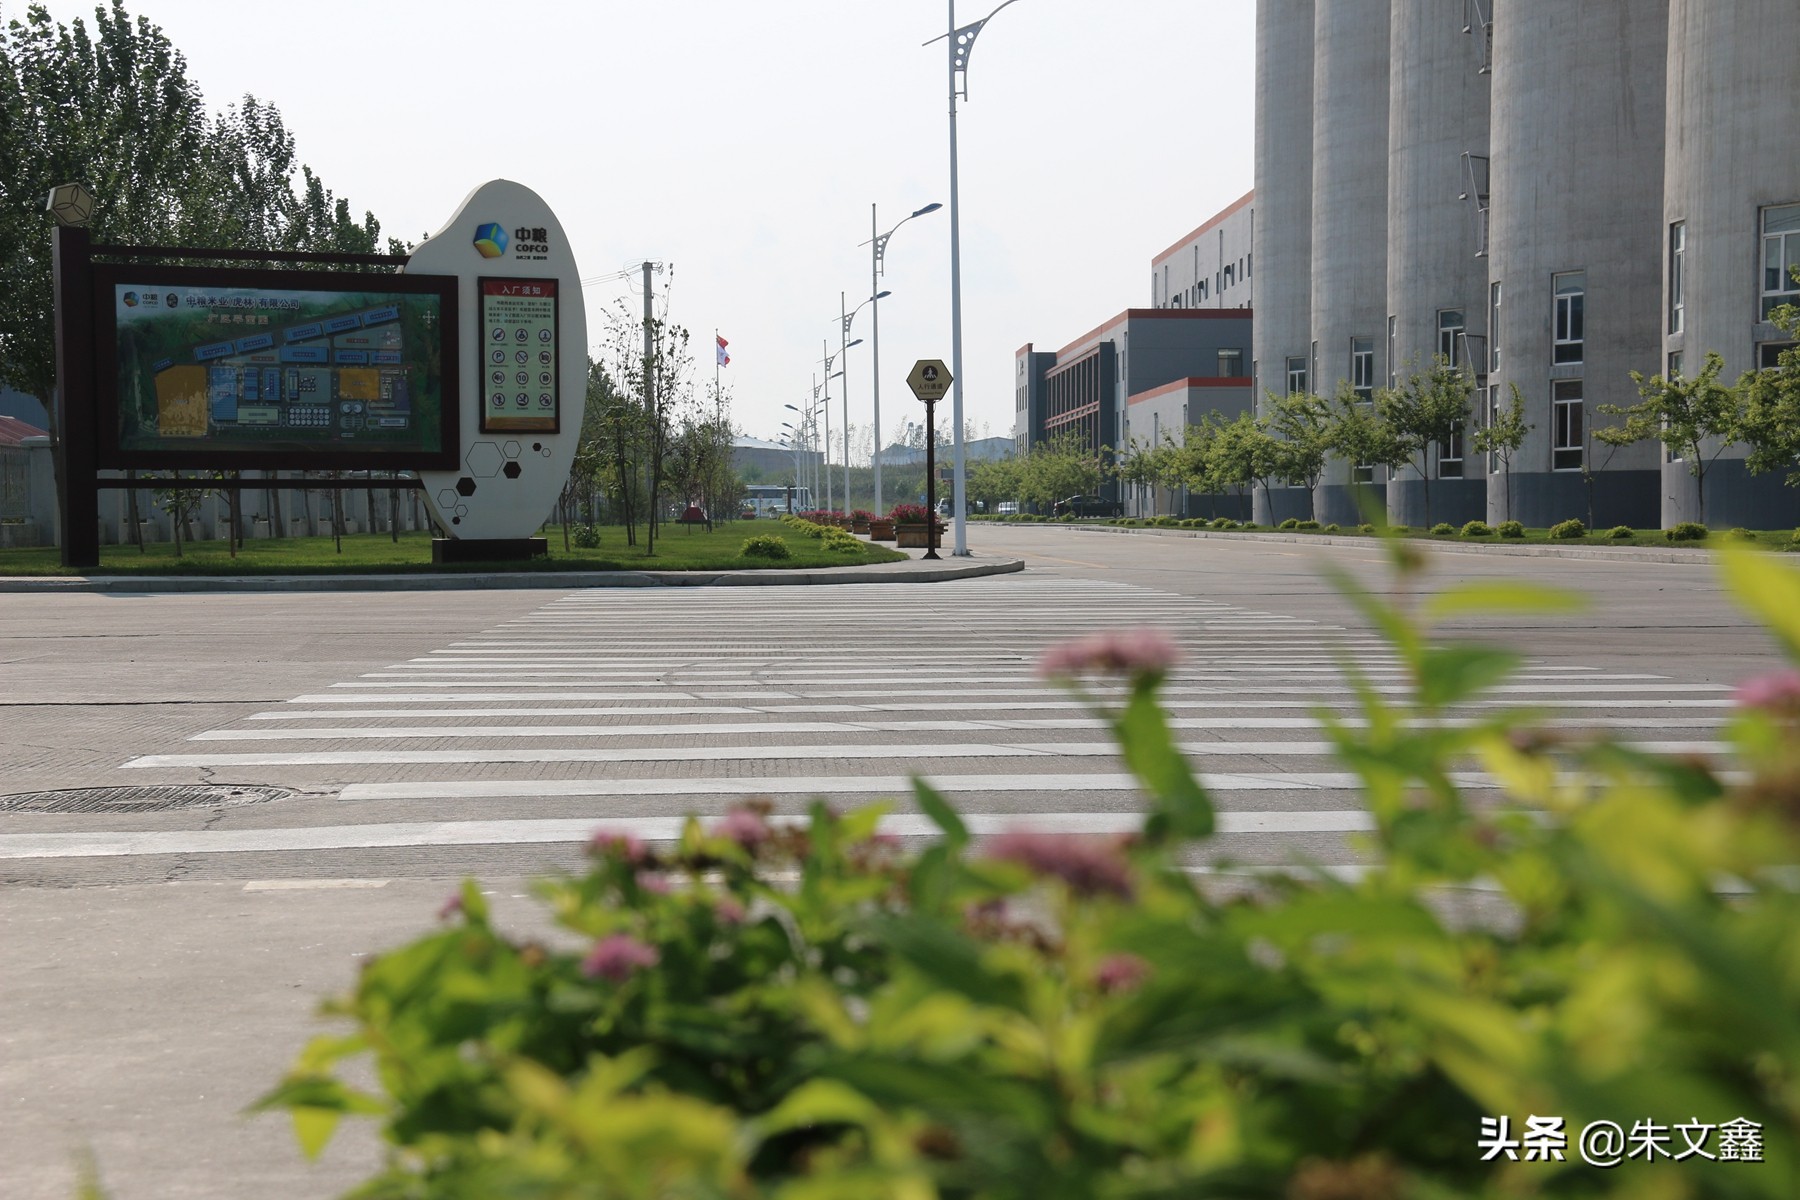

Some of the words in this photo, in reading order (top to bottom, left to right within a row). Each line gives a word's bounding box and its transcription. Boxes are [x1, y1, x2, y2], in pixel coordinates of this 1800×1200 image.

[515, 227, 547, 243] 中粮
[515, 244, 549, 253] COFCO
[502, 285, 541, 295] 入厂须知
